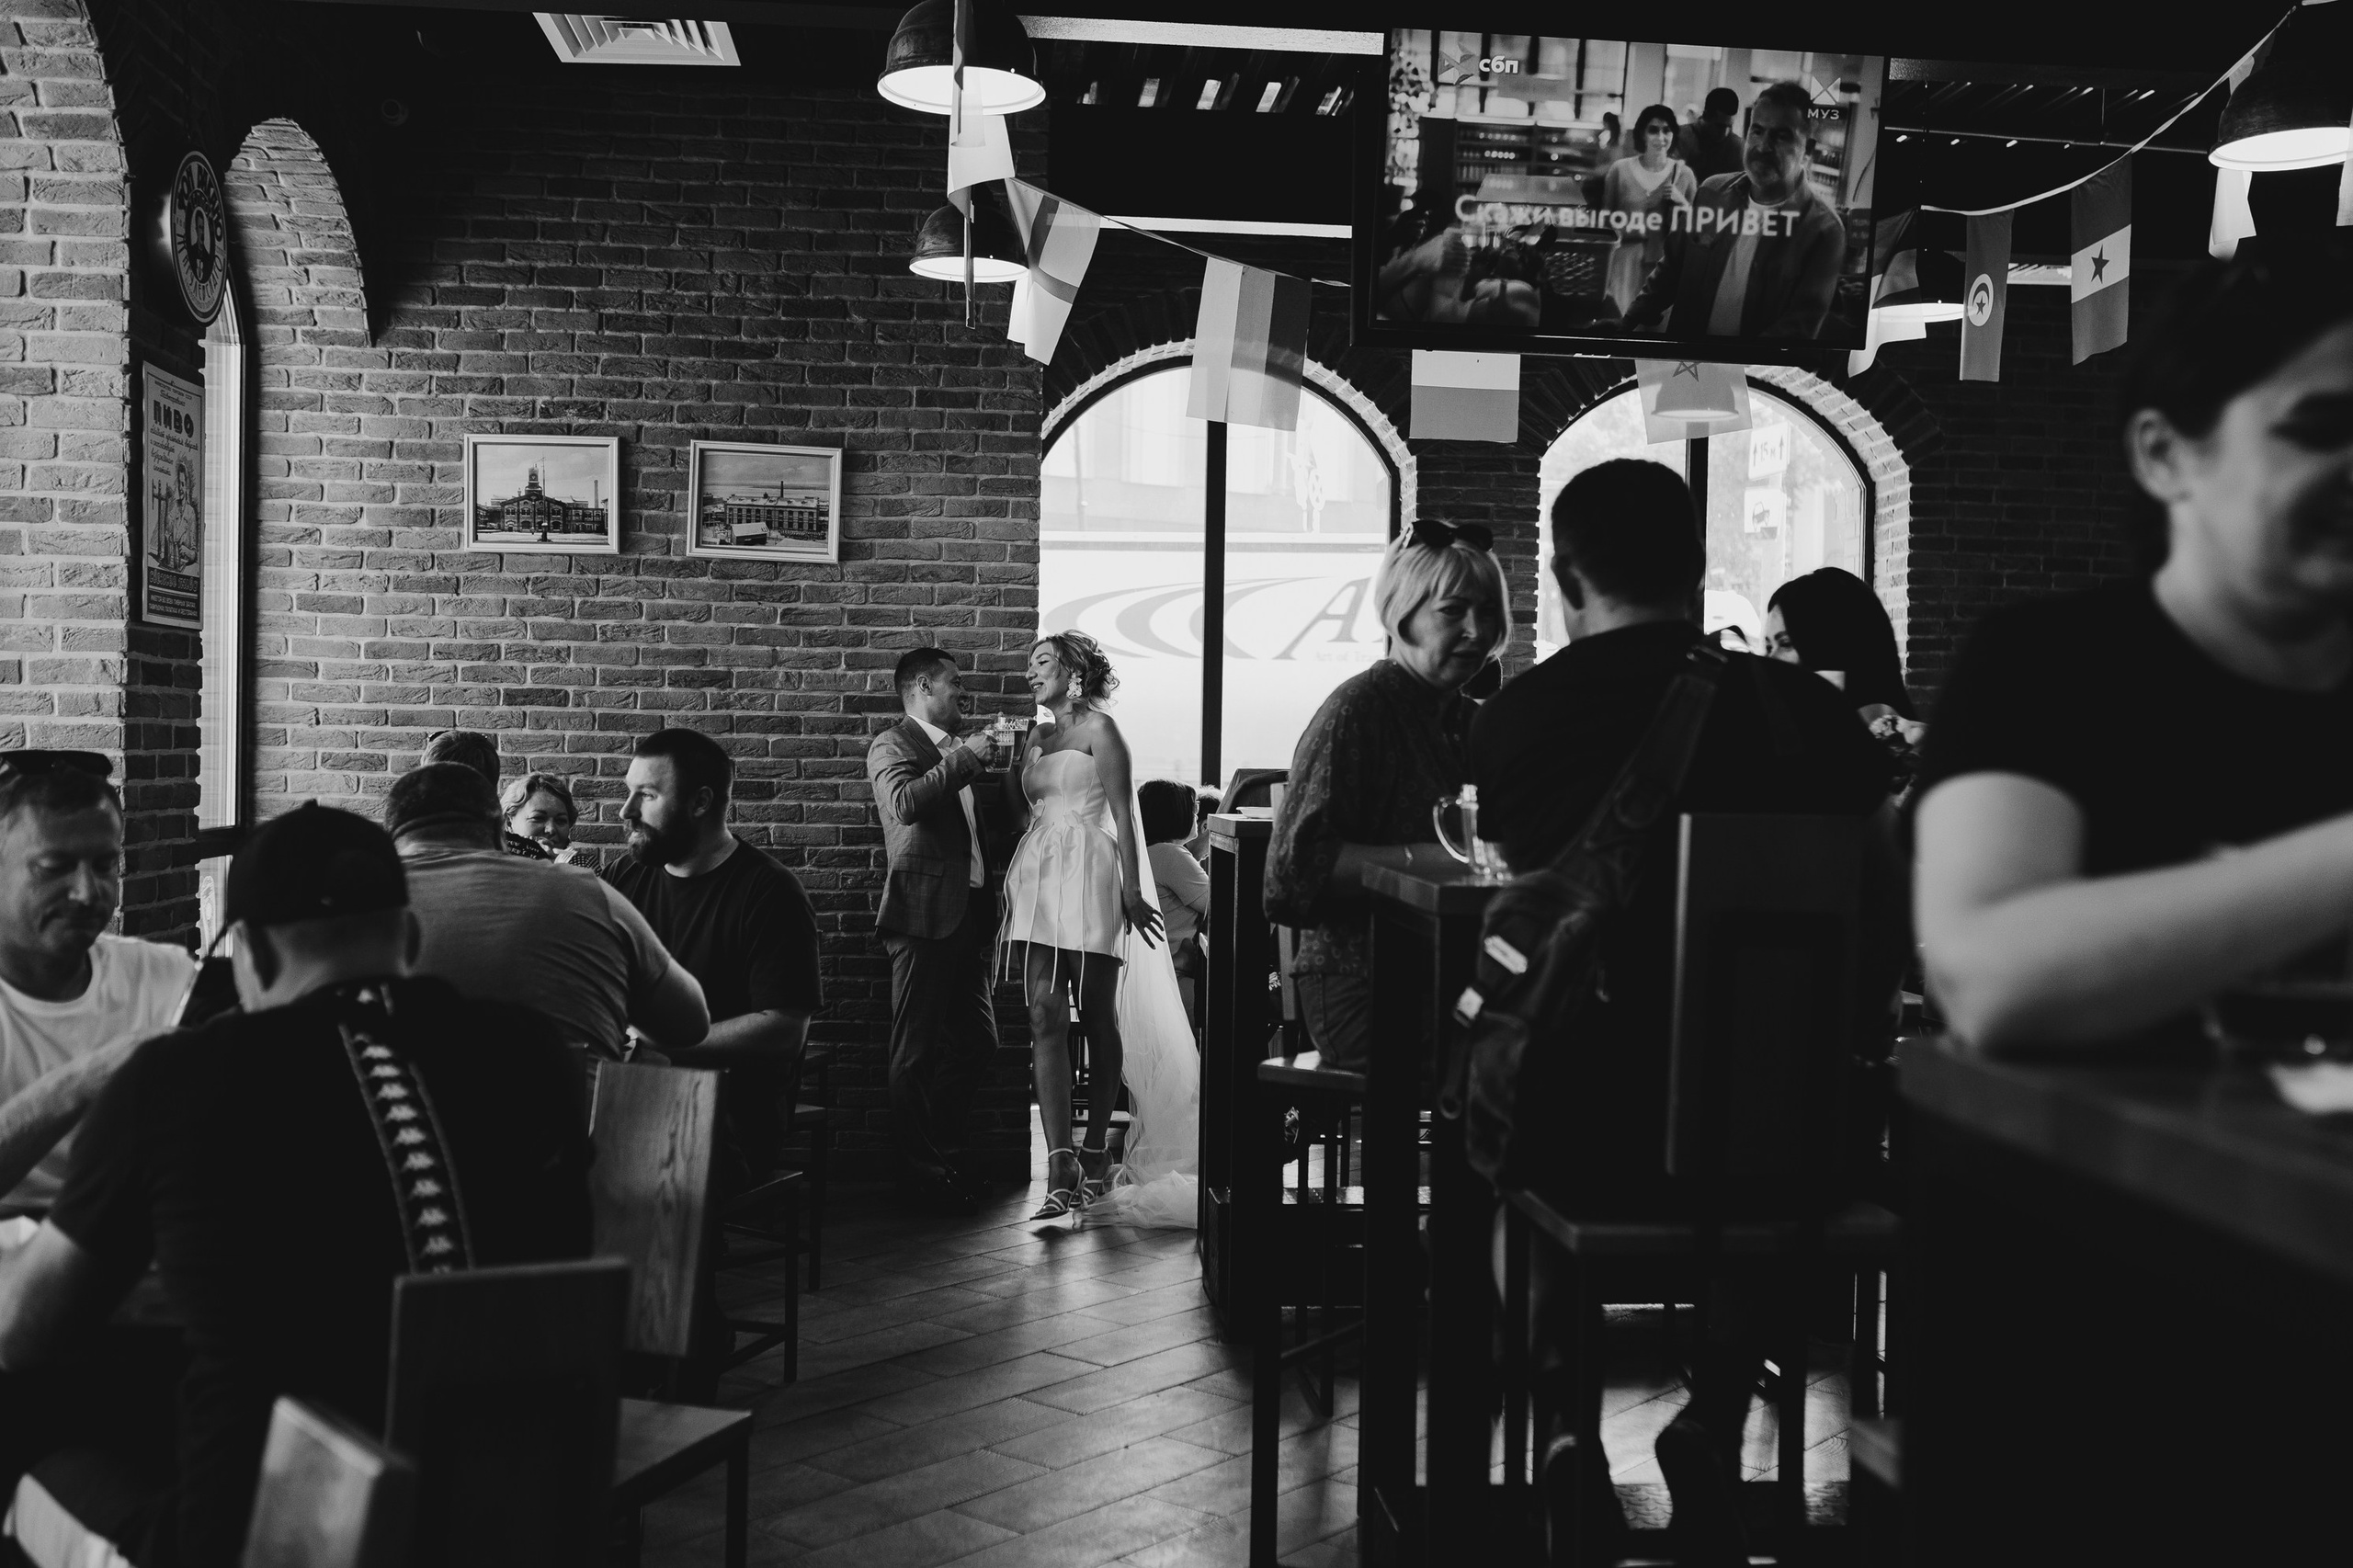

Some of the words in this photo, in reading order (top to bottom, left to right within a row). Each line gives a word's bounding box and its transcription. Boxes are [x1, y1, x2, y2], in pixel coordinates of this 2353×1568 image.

[1479, 55, 1519, 74] сбп
[1807, 108, 1840, 120] МУЗ
[1455, 194, 1553, 227] Скажи
[1559, 206, 1663, 235] выгоде
[1670, 204, 1801, 238] ПРИВЕТ
[153, 399, 194, 438] ПИВО
